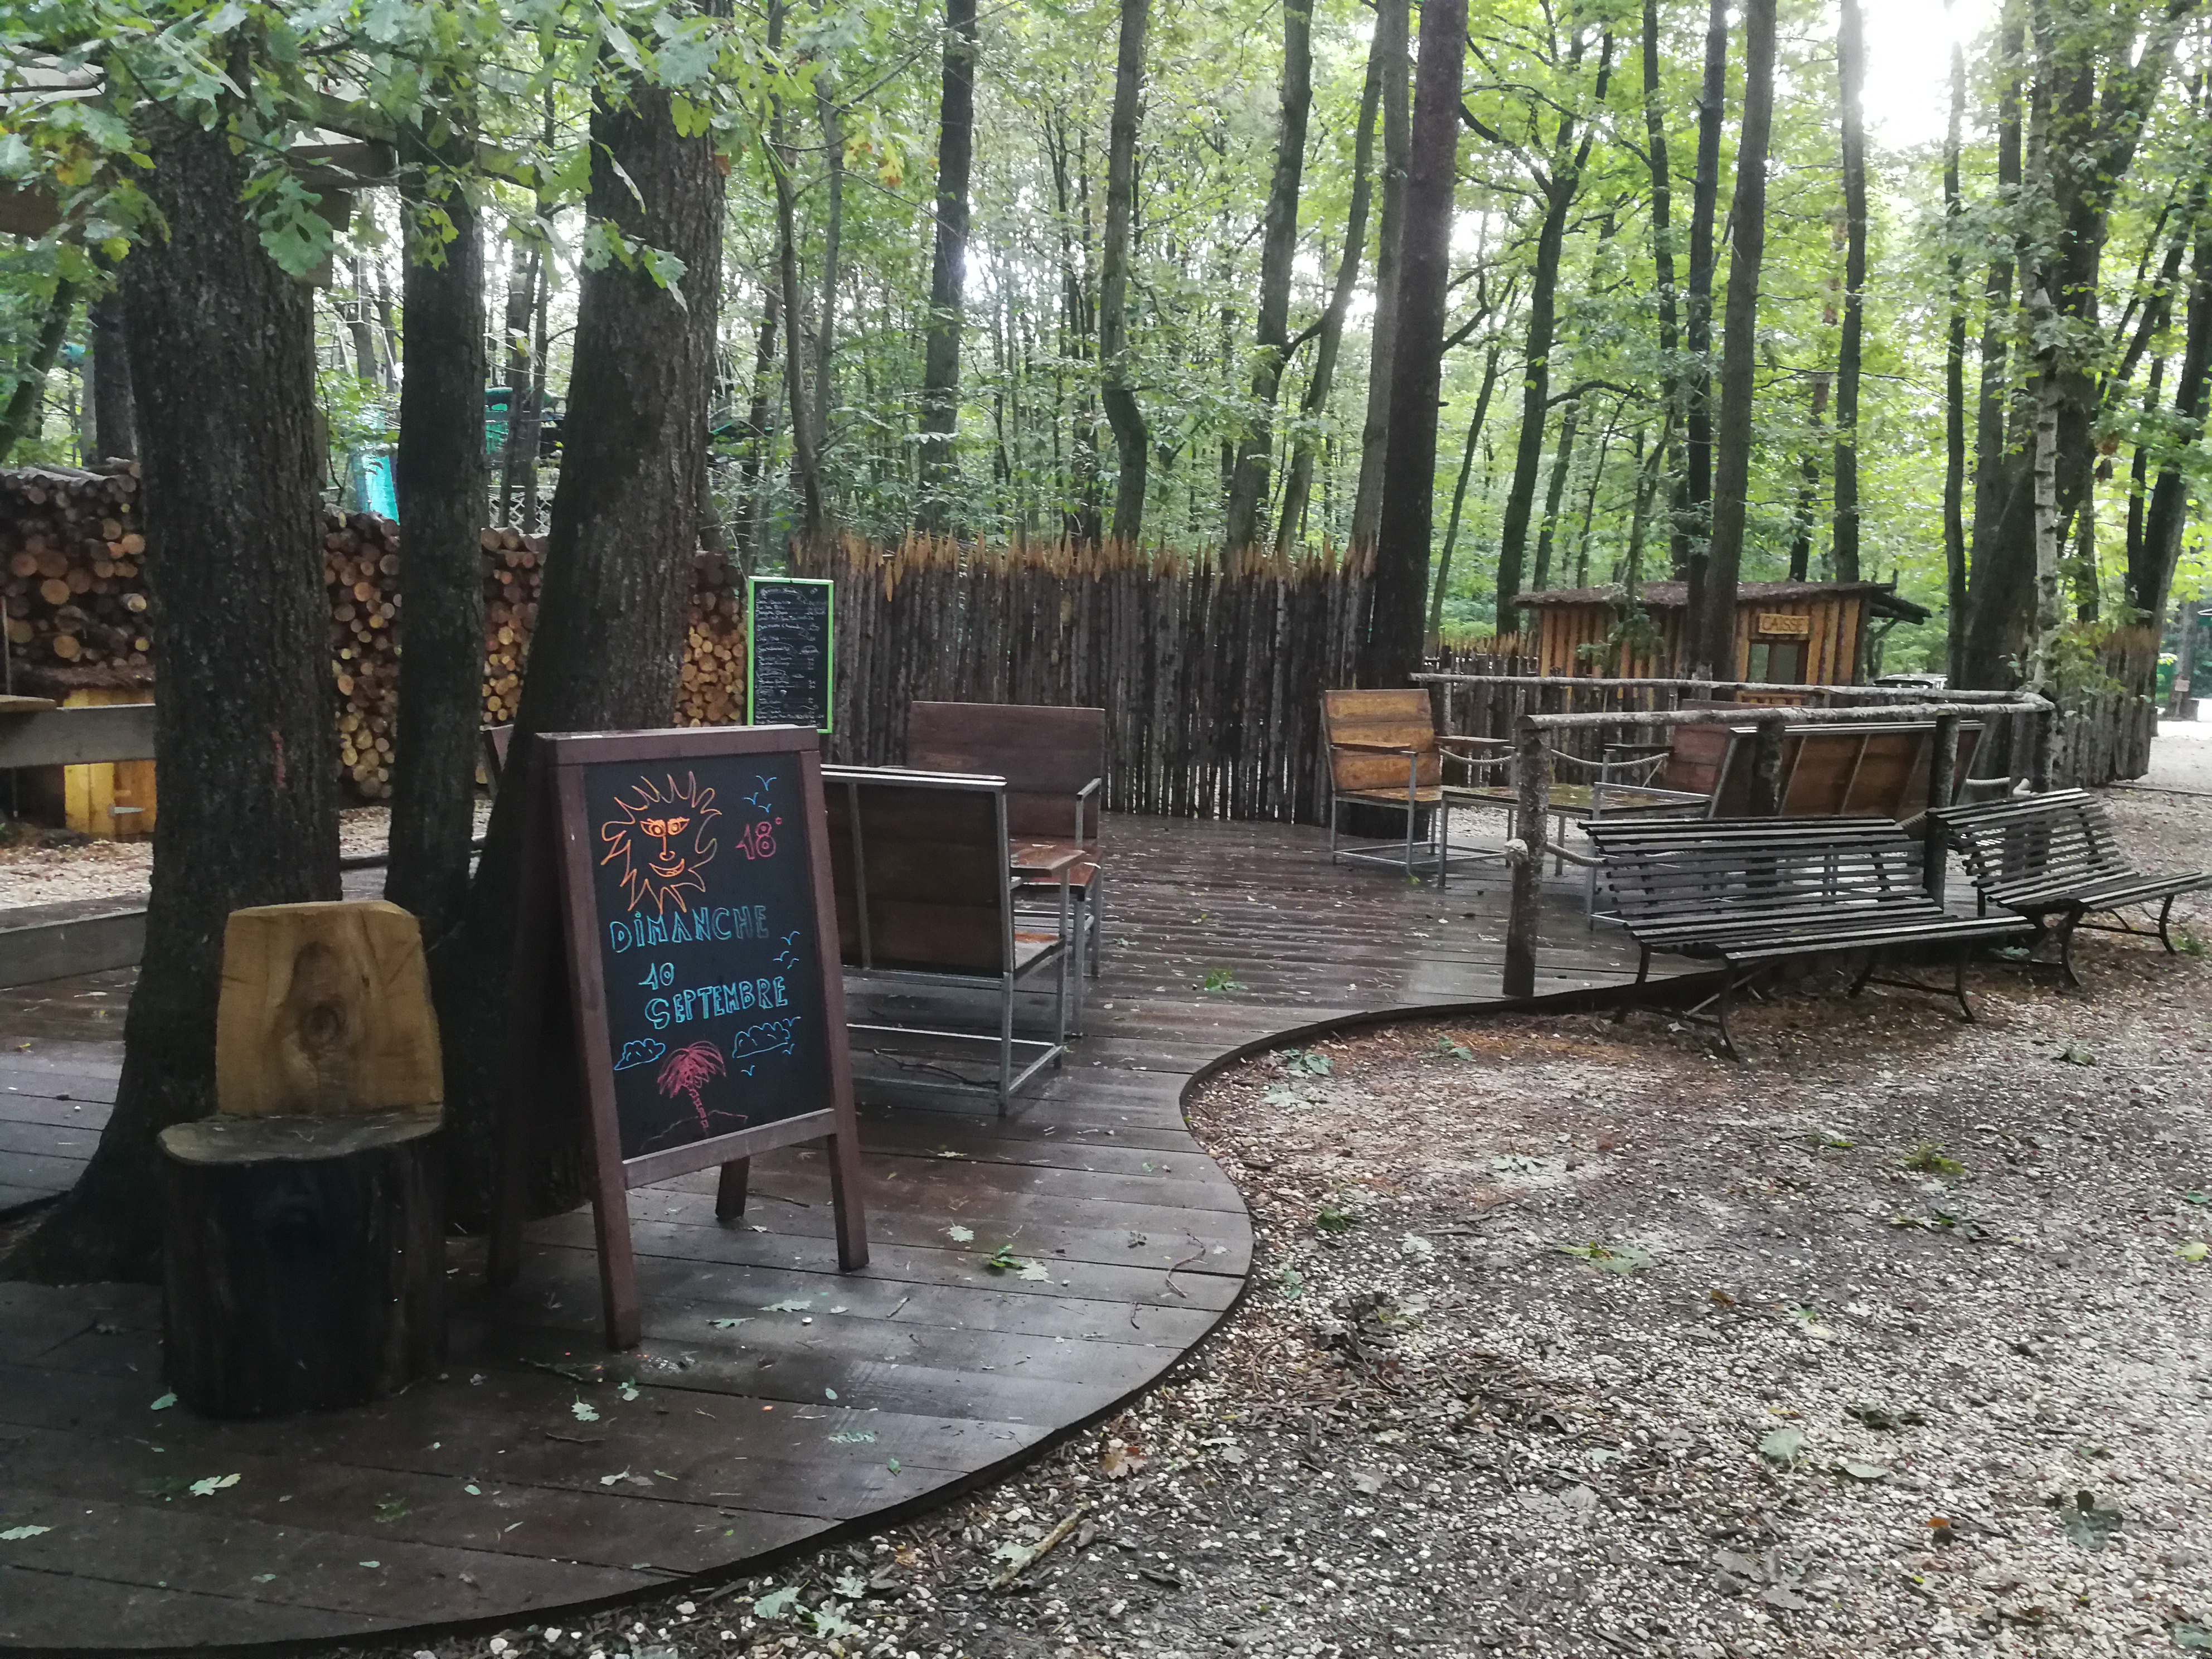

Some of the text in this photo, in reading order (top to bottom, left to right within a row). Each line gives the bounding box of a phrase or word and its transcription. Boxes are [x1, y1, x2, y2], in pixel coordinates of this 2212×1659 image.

[1762, 615, 1805, 632] CAISSE
[639, 962, 675, 990] 10
[645, 977, 788, 1029] SEPTEMBRE
